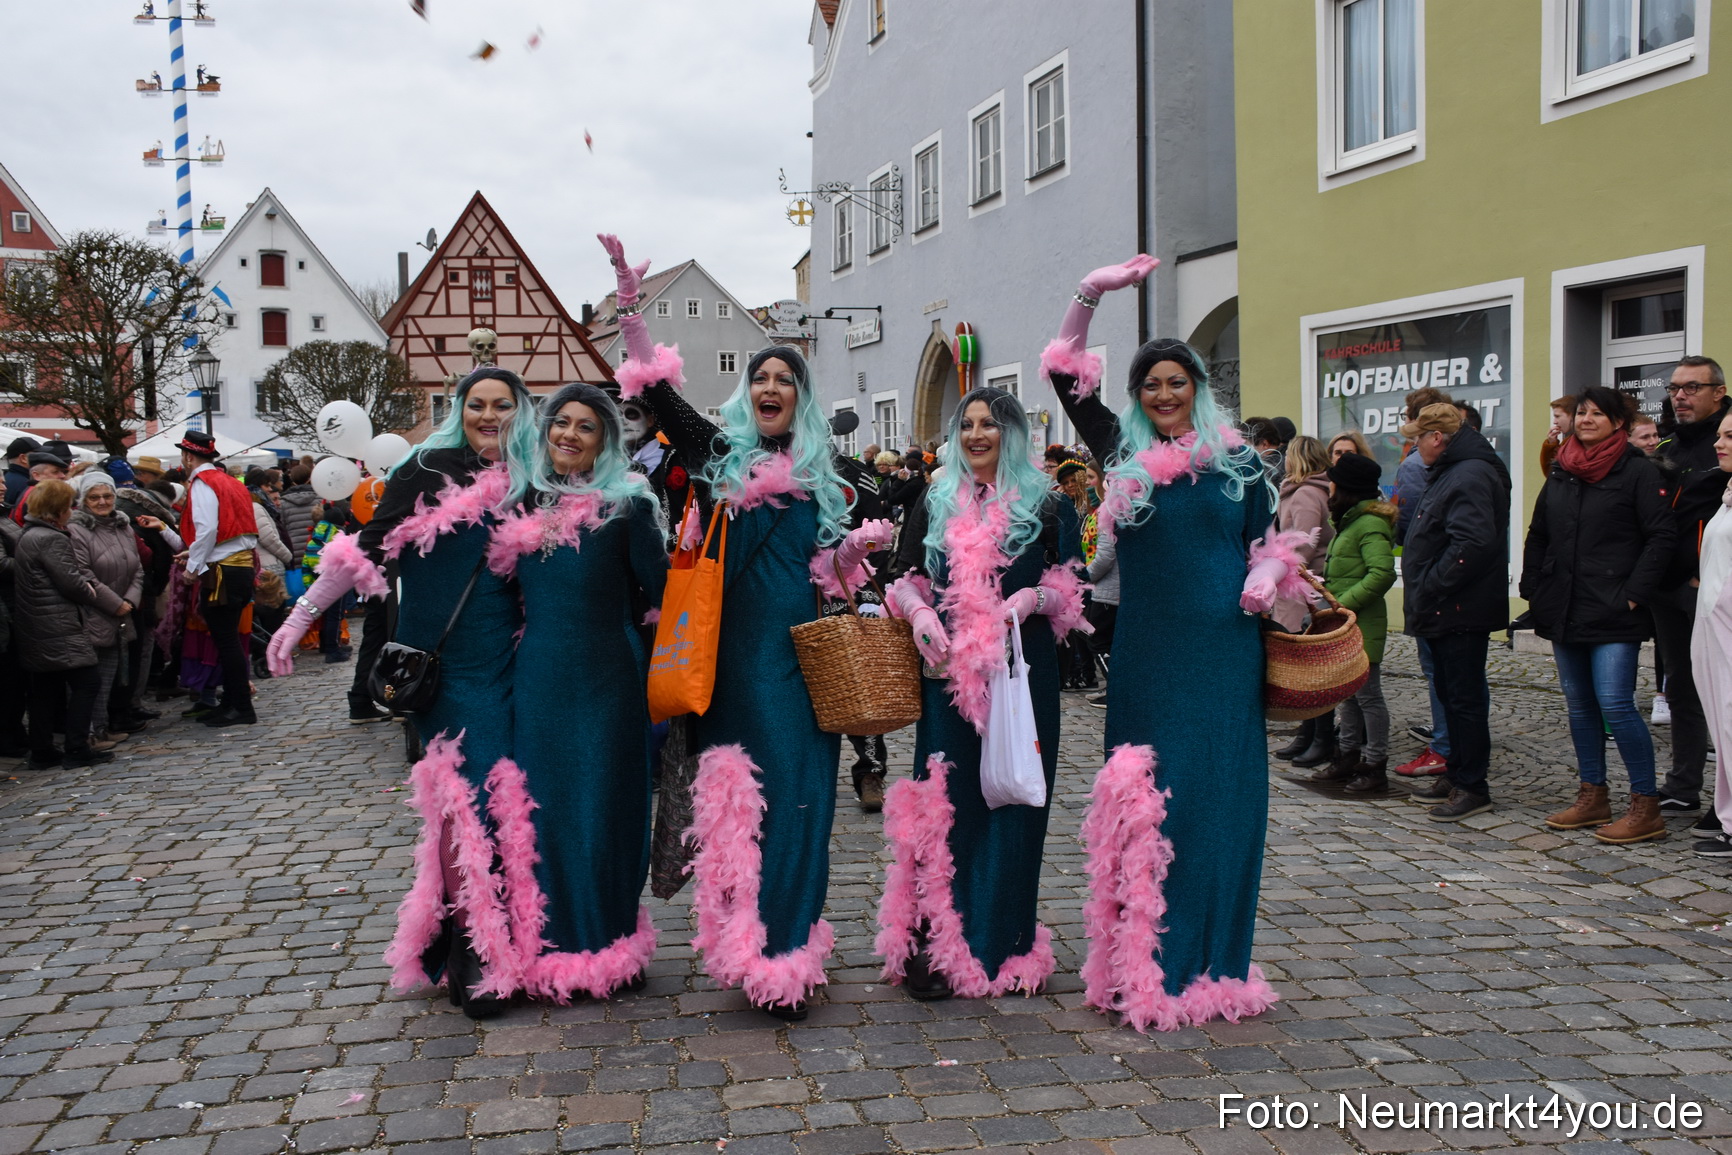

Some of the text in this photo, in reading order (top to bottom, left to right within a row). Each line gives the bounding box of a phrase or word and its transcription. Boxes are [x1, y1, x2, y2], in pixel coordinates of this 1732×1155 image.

[1323, 338, 1402, 360] FAHRSCHULE
[1323, 353, 1502, 398] HOFBAUER &
[1618, 378, 1665, 390] ANMELDUNG:
[1647, 402, 1663, 411] UHR
